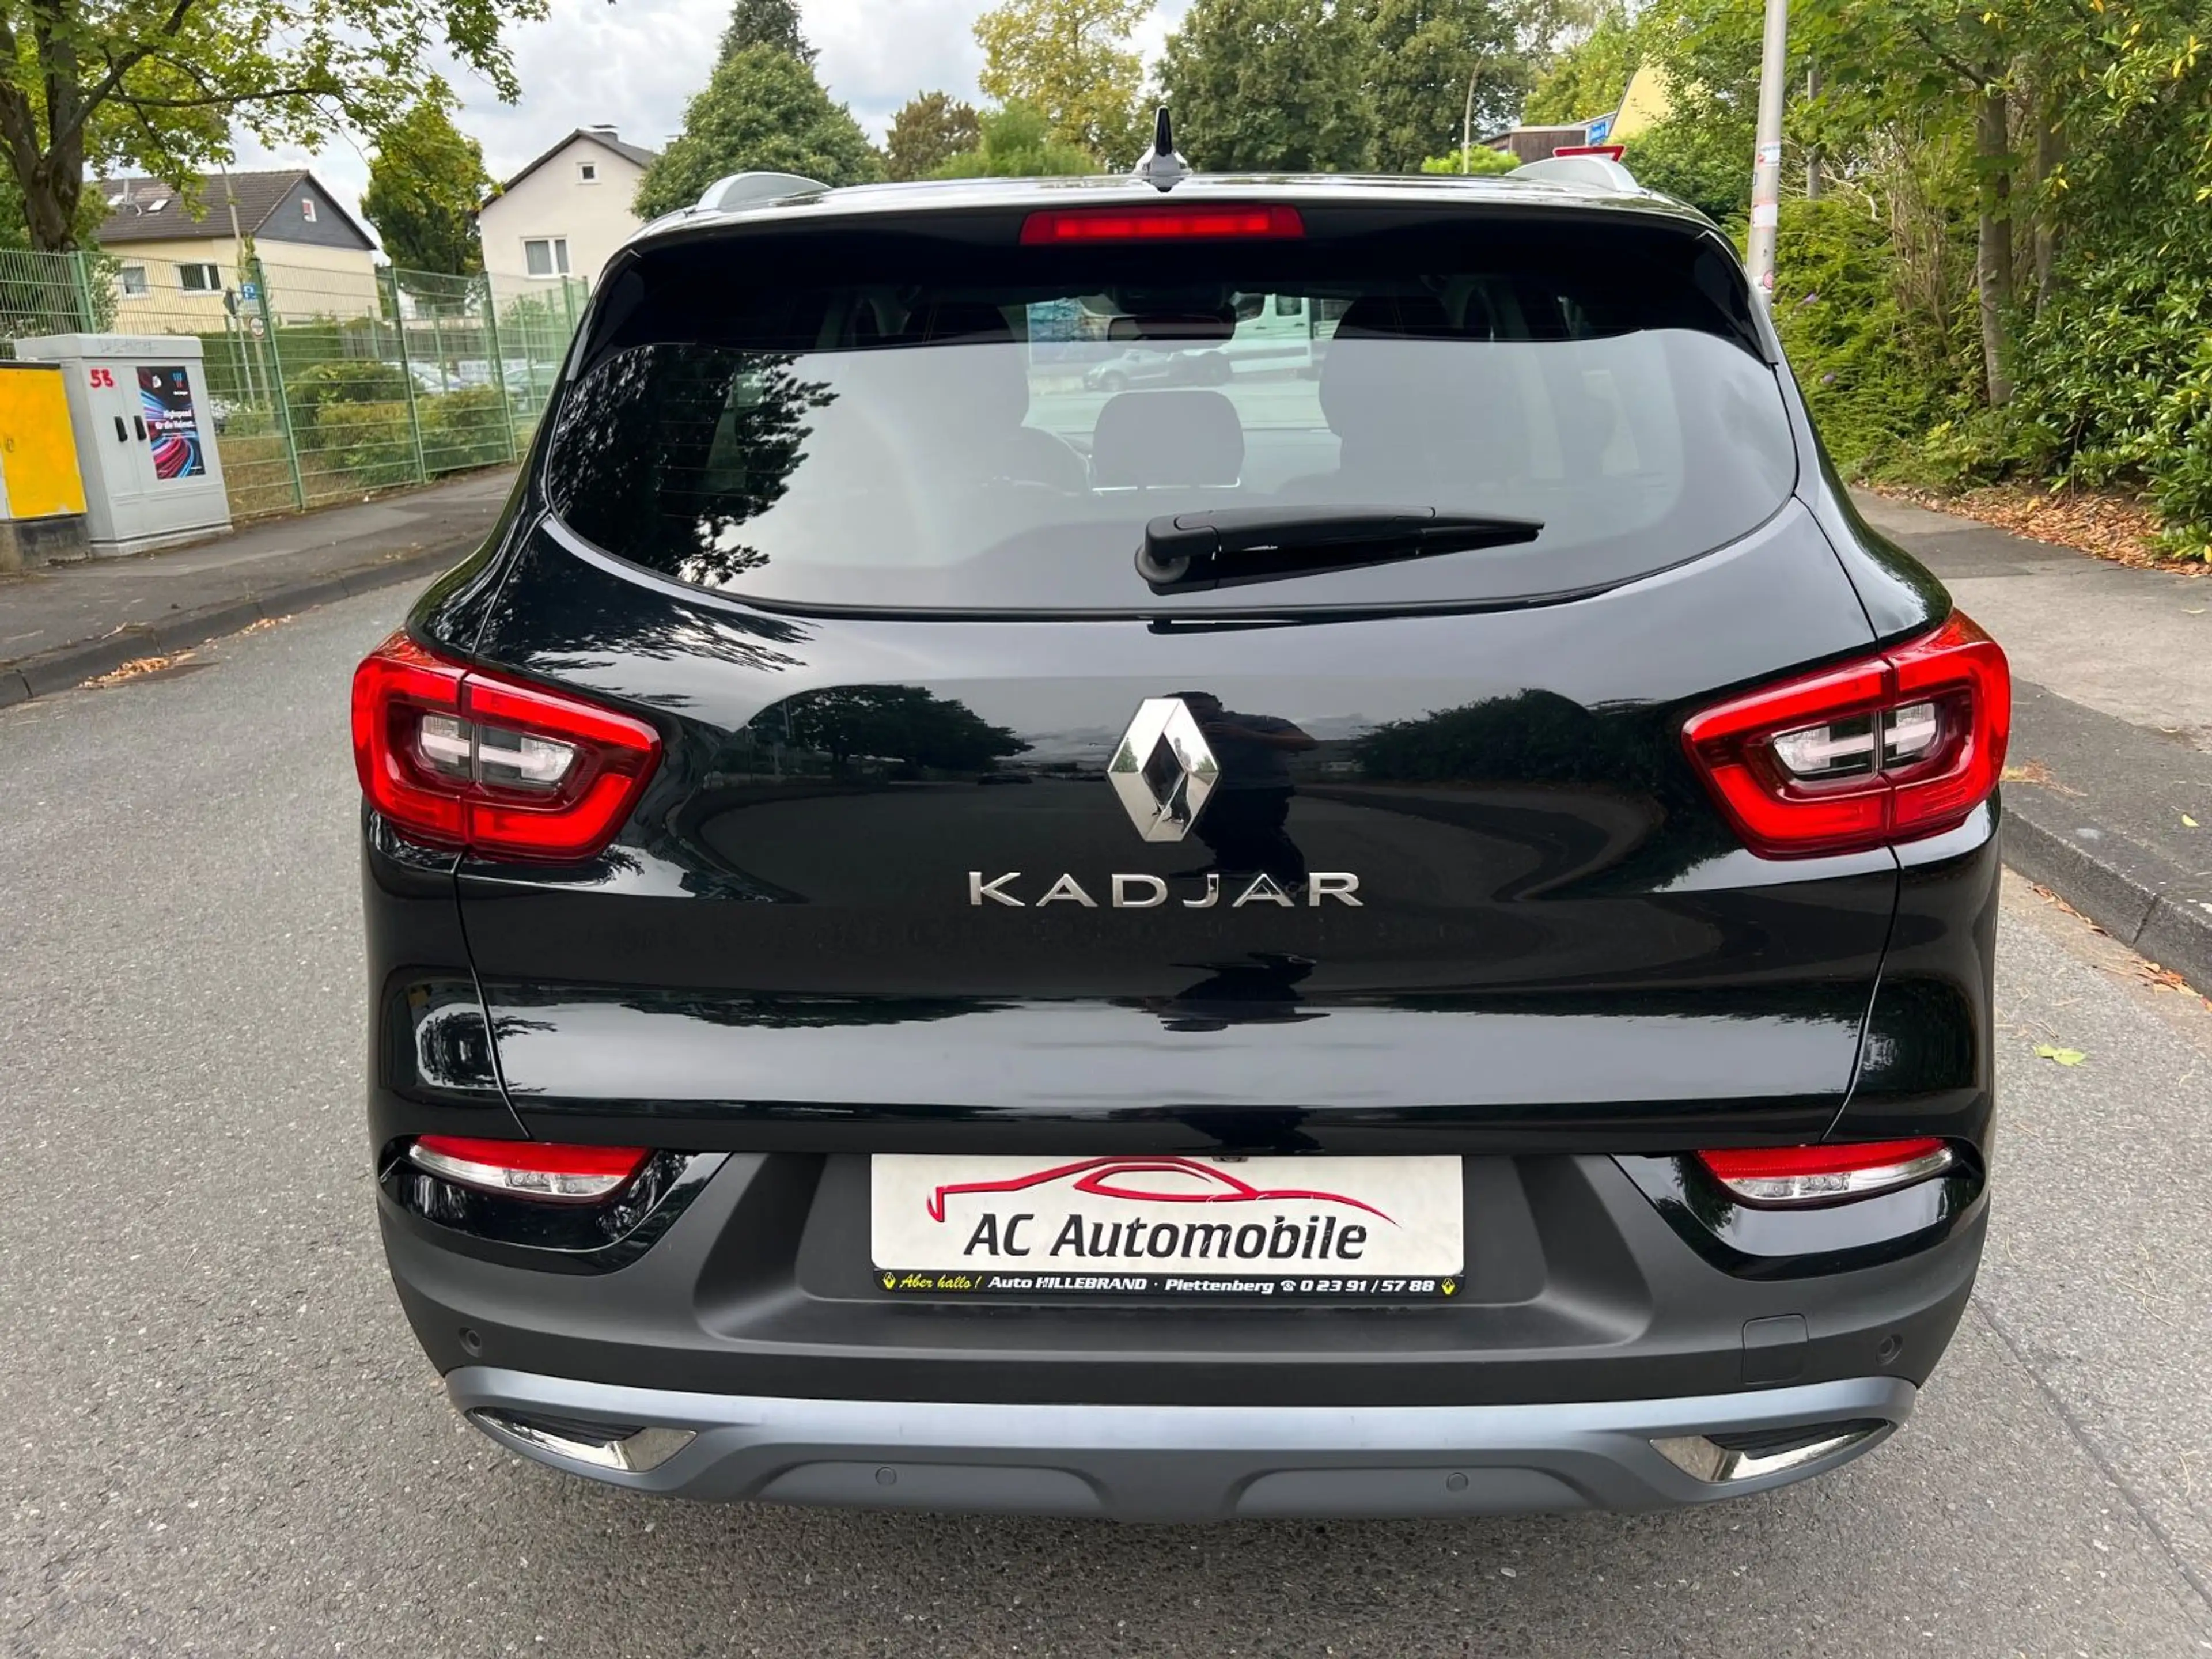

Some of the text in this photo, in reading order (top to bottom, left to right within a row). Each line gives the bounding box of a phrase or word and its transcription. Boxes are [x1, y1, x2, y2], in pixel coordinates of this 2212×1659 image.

[968, 870, 1364, 908] KADJAR
[963, 1213, 1368, 1260] AC Automobile
[899, 1273, 934, 1289] Aber
[988, 1275, 1033, 1289] Auto
[1035, 1277, 1147, 1290] HILLEBRAND
[1164, 1278, 1274, 1295] Plettenberg
[1408, 1280, 1435, 1293] 88
